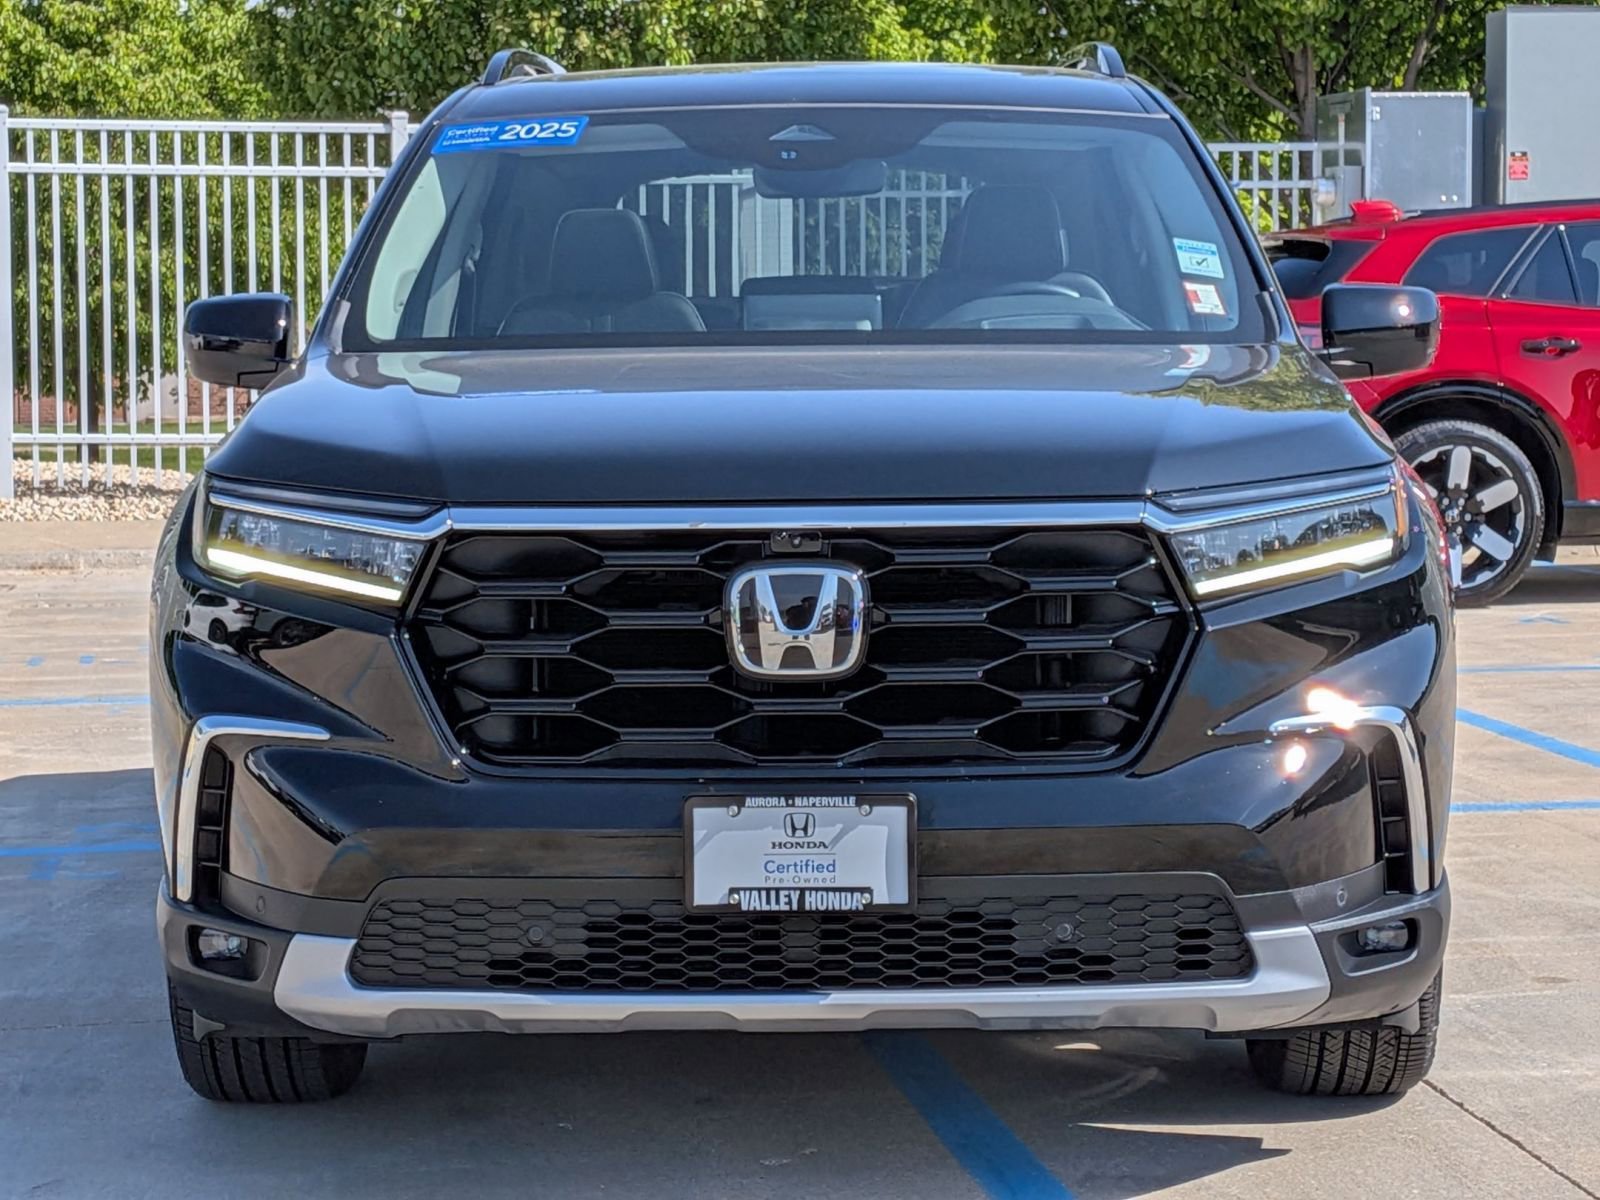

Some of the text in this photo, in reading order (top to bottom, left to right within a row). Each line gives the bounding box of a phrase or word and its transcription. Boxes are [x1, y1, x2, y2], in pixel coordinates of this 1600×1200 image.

[447, 125, 499, 137] Certified
[498, 121, 580, 140] 2025
[745, 796, 856, 807] AURORA NAPERVILLE
[771, 841, 829, 850] HONDA
[763, 859, 836, 874] Certified
[764, 875, 836, 884] Pre-Owned
[740, 890, 864, 911] VALLEY HONDA
